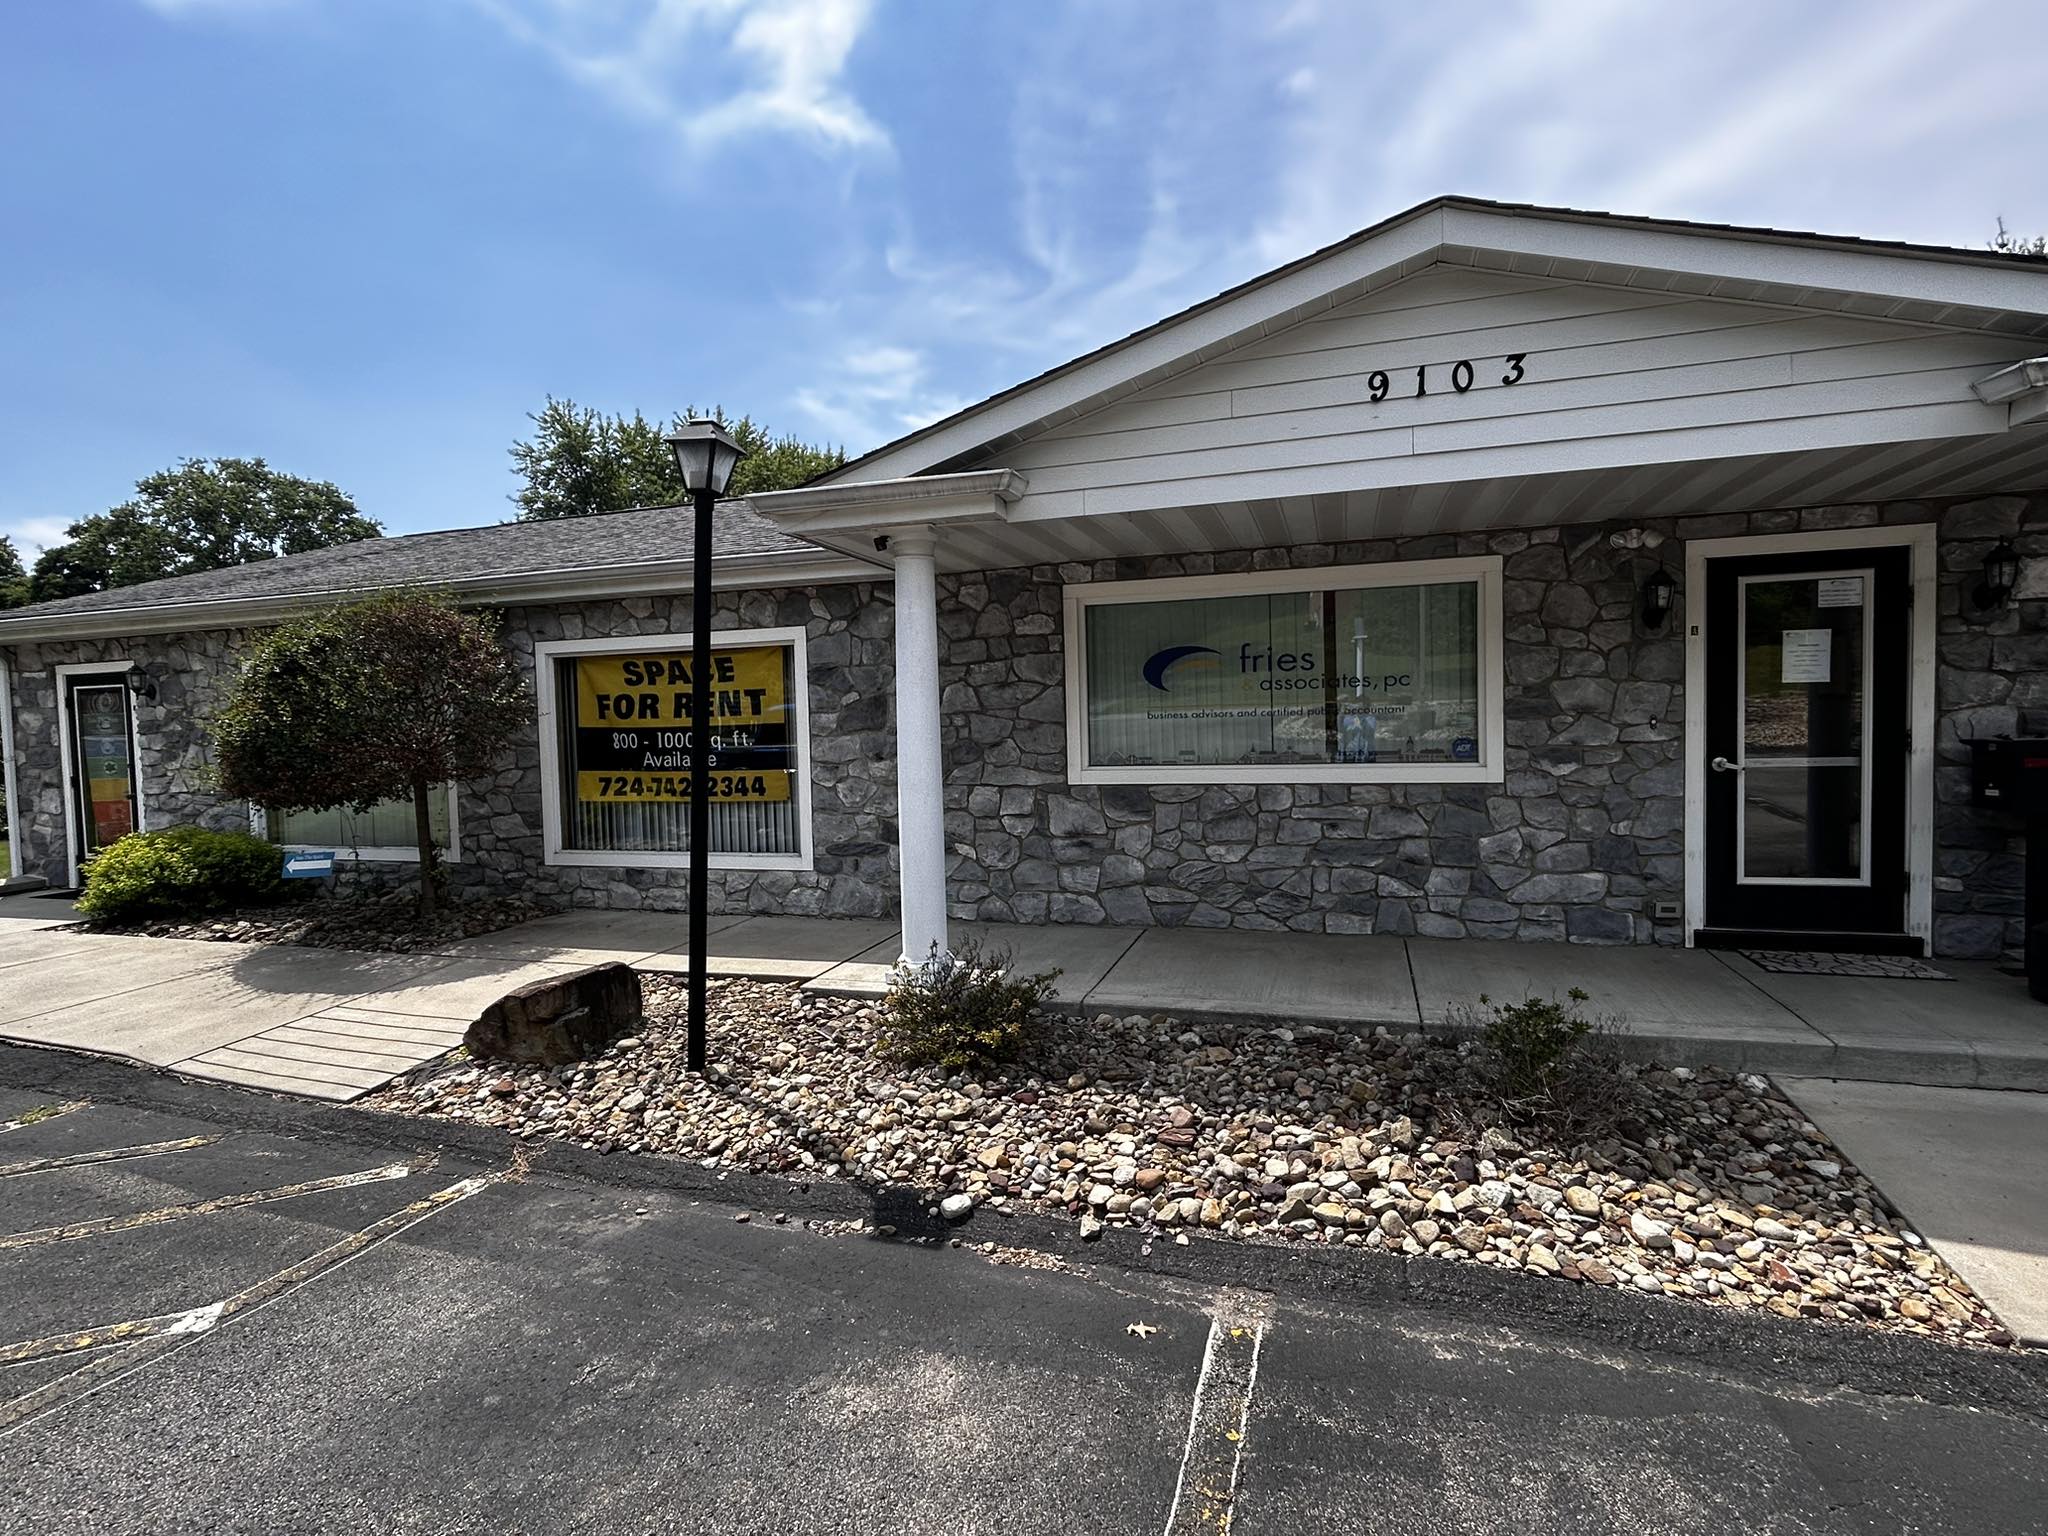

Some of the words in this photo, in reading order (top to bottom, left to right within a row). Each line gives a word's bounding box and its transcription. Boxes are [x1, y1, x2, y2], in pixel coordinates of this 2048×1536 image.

[1367, 353, 1527, 402] 9103
[1240, 643, 1315, 673] fries
[622, 656, 735, 687] SPAE
[1260, 673, 1378, 691] associates,
[1384, 674, 1411, 692] pc
[596, 693, 660, 720] FOR
[673, 688, 766, 719] RNT
[1147, 710, 1188, 720] business
[1191, 708, 1234, 719] advisors
[1236, 707, 1257, 718] and
[1260, 706, 1303, 717] certified
[613, 732, 638, 749] 800
[733, 730, 753, 747] ft.
[643, 751, 717, 767] Availae
[598, 776, 767, 797] 724-7422344
